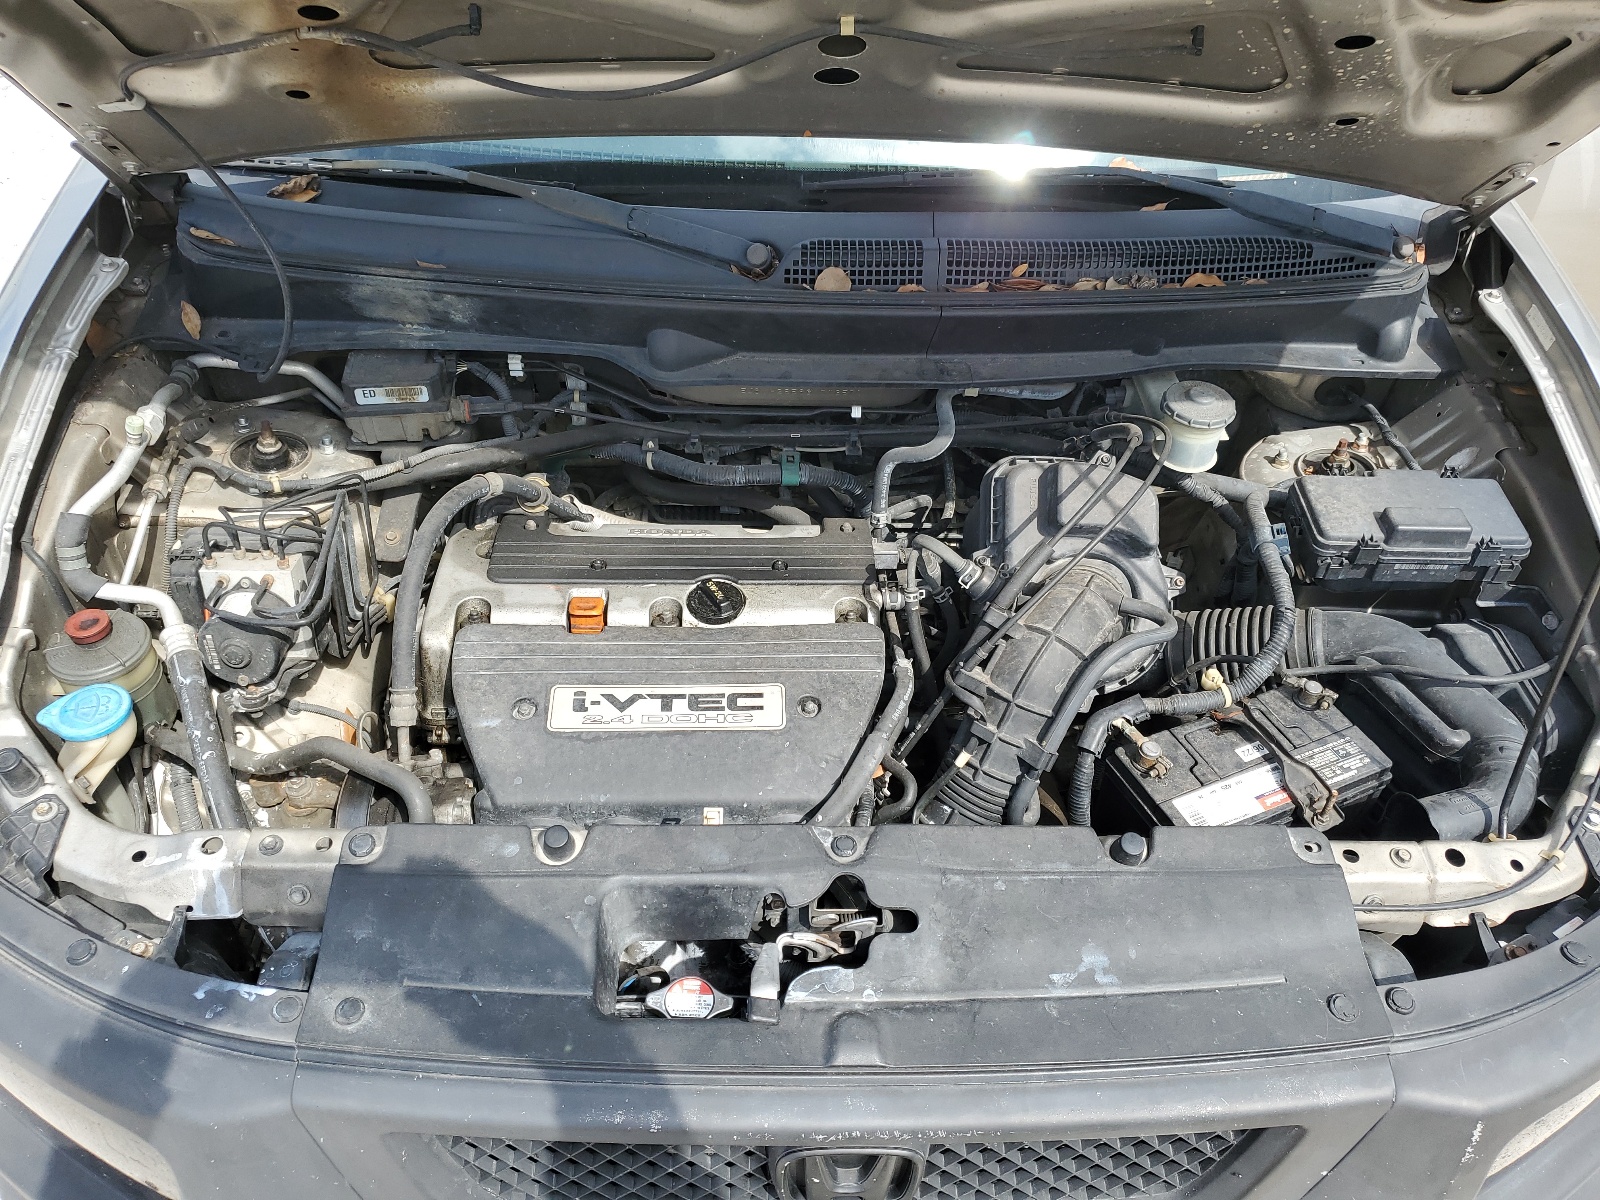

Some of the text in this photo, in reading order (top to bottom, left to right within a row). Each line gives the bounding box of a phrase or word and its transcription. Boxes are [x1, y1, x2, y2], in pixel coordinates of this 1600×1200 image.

[361, 389, 376, 399] ED
[628, 528, 716, 537] HONDA
[572, 690, 765, 713] i-VTEC
[581, 713, 754, 725] 2.4 DOHC
[1241, 743, 1265, 757] 06/22
